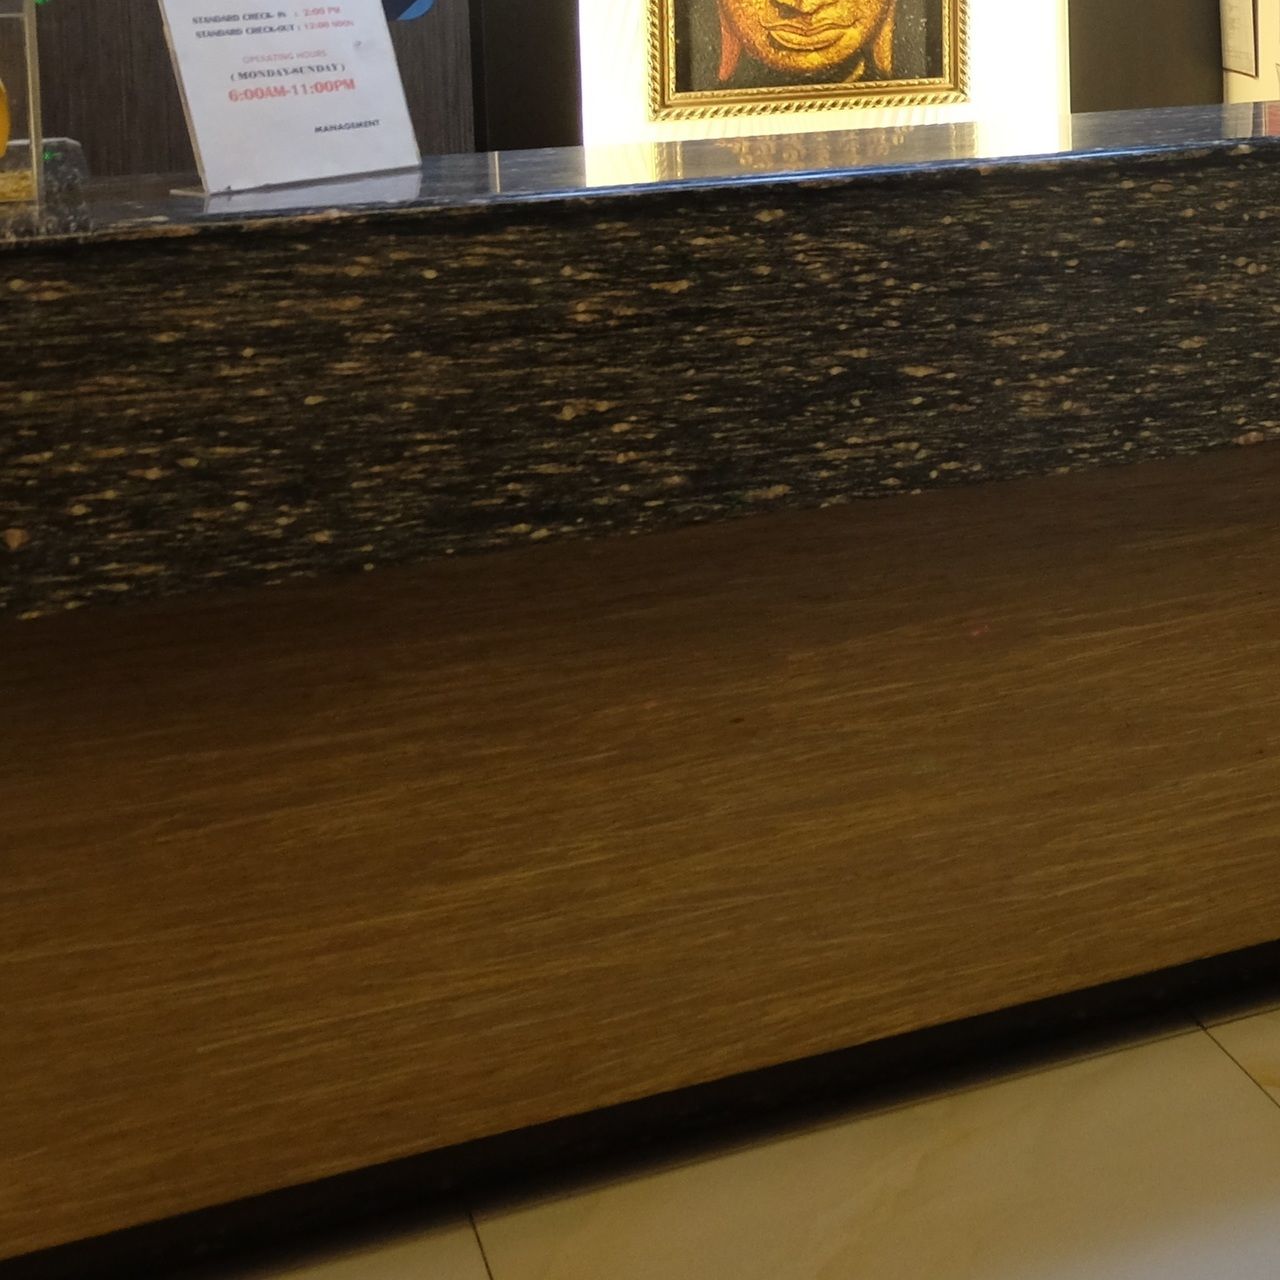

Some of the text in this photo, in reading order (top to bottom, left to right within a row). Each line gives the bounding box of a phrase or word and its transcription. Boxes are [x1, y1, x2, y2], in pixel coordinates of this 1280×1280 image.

[192, 14, 241, 25] STANDARD
[195, 28, 244, 39] STANDARD
[242, 49, 328, 64] OPERATING HOURS
[227, 78, 356, 102] 6:00AM-11:00PM
[314, 119, 380, 133] MANAGEMENT
